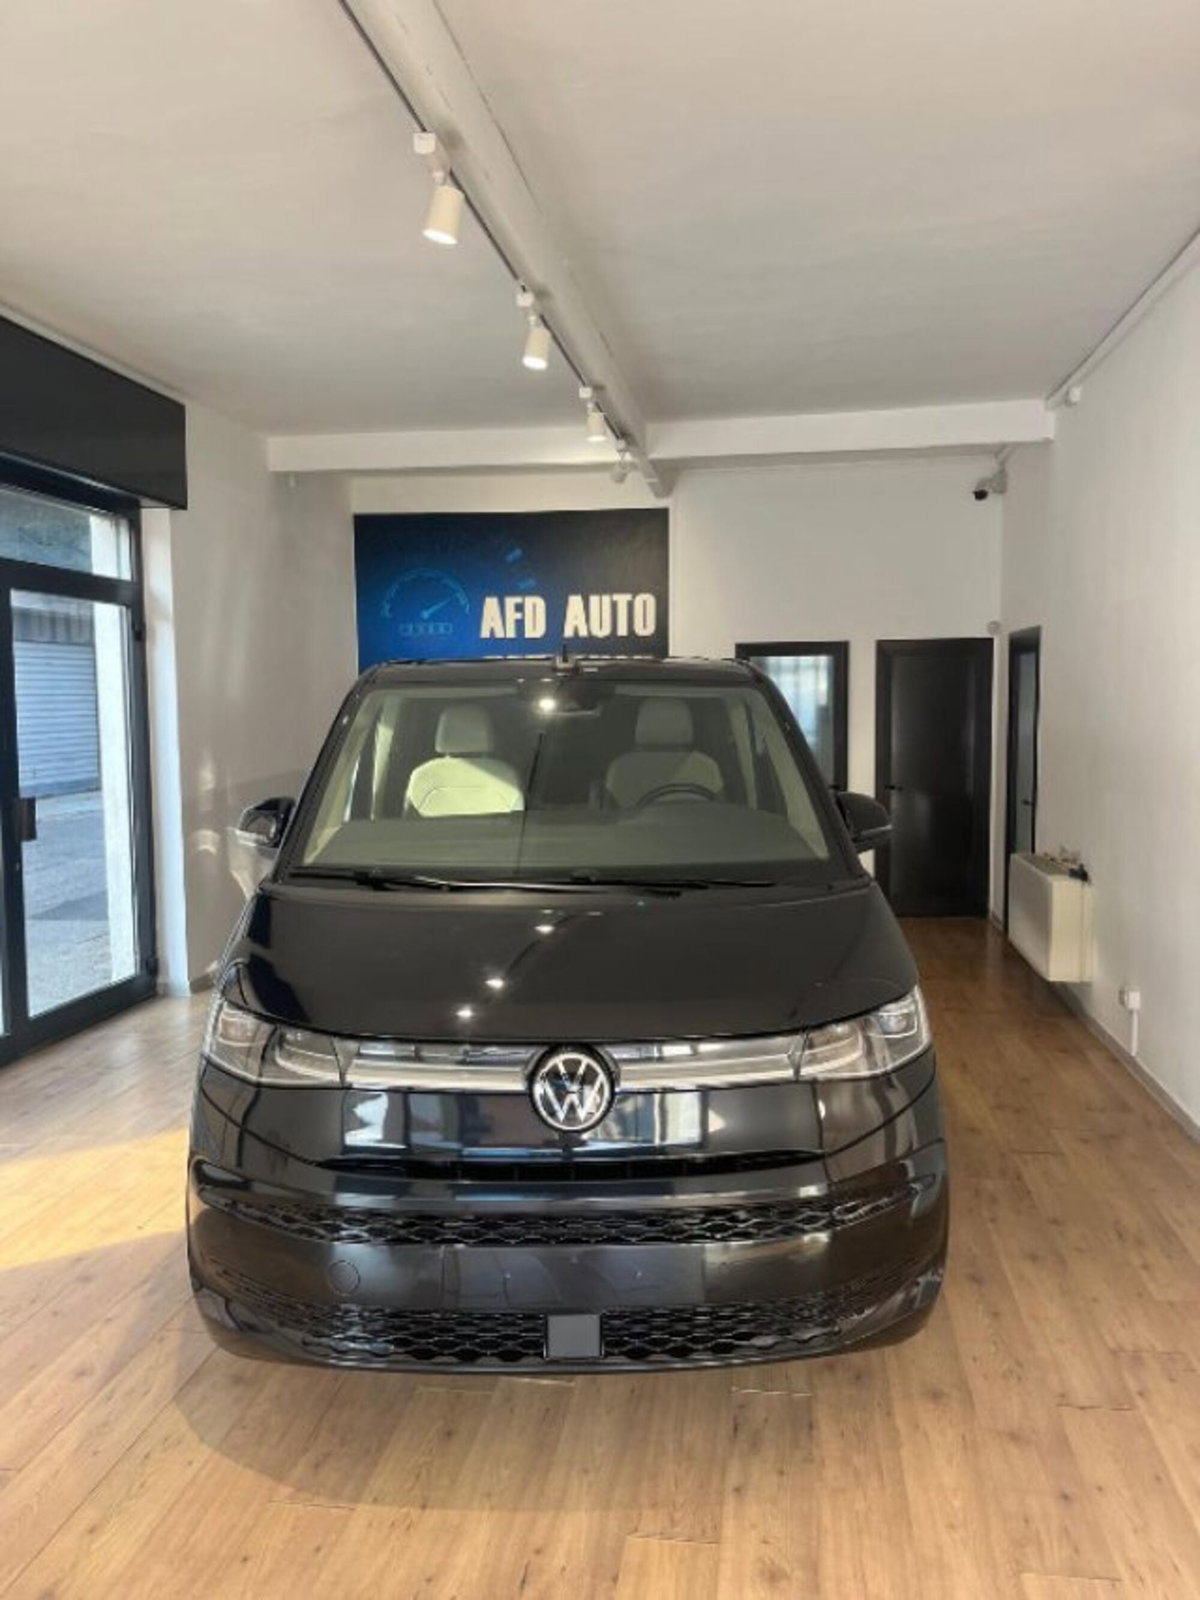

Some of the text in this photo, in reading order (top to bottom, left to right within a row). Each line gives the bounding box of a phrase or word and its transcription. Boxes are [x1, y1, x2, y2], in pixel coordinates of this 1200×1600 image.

[480, 593, 656, 638] AFD AUTO
[535, 1055, 608, 1126] VW
